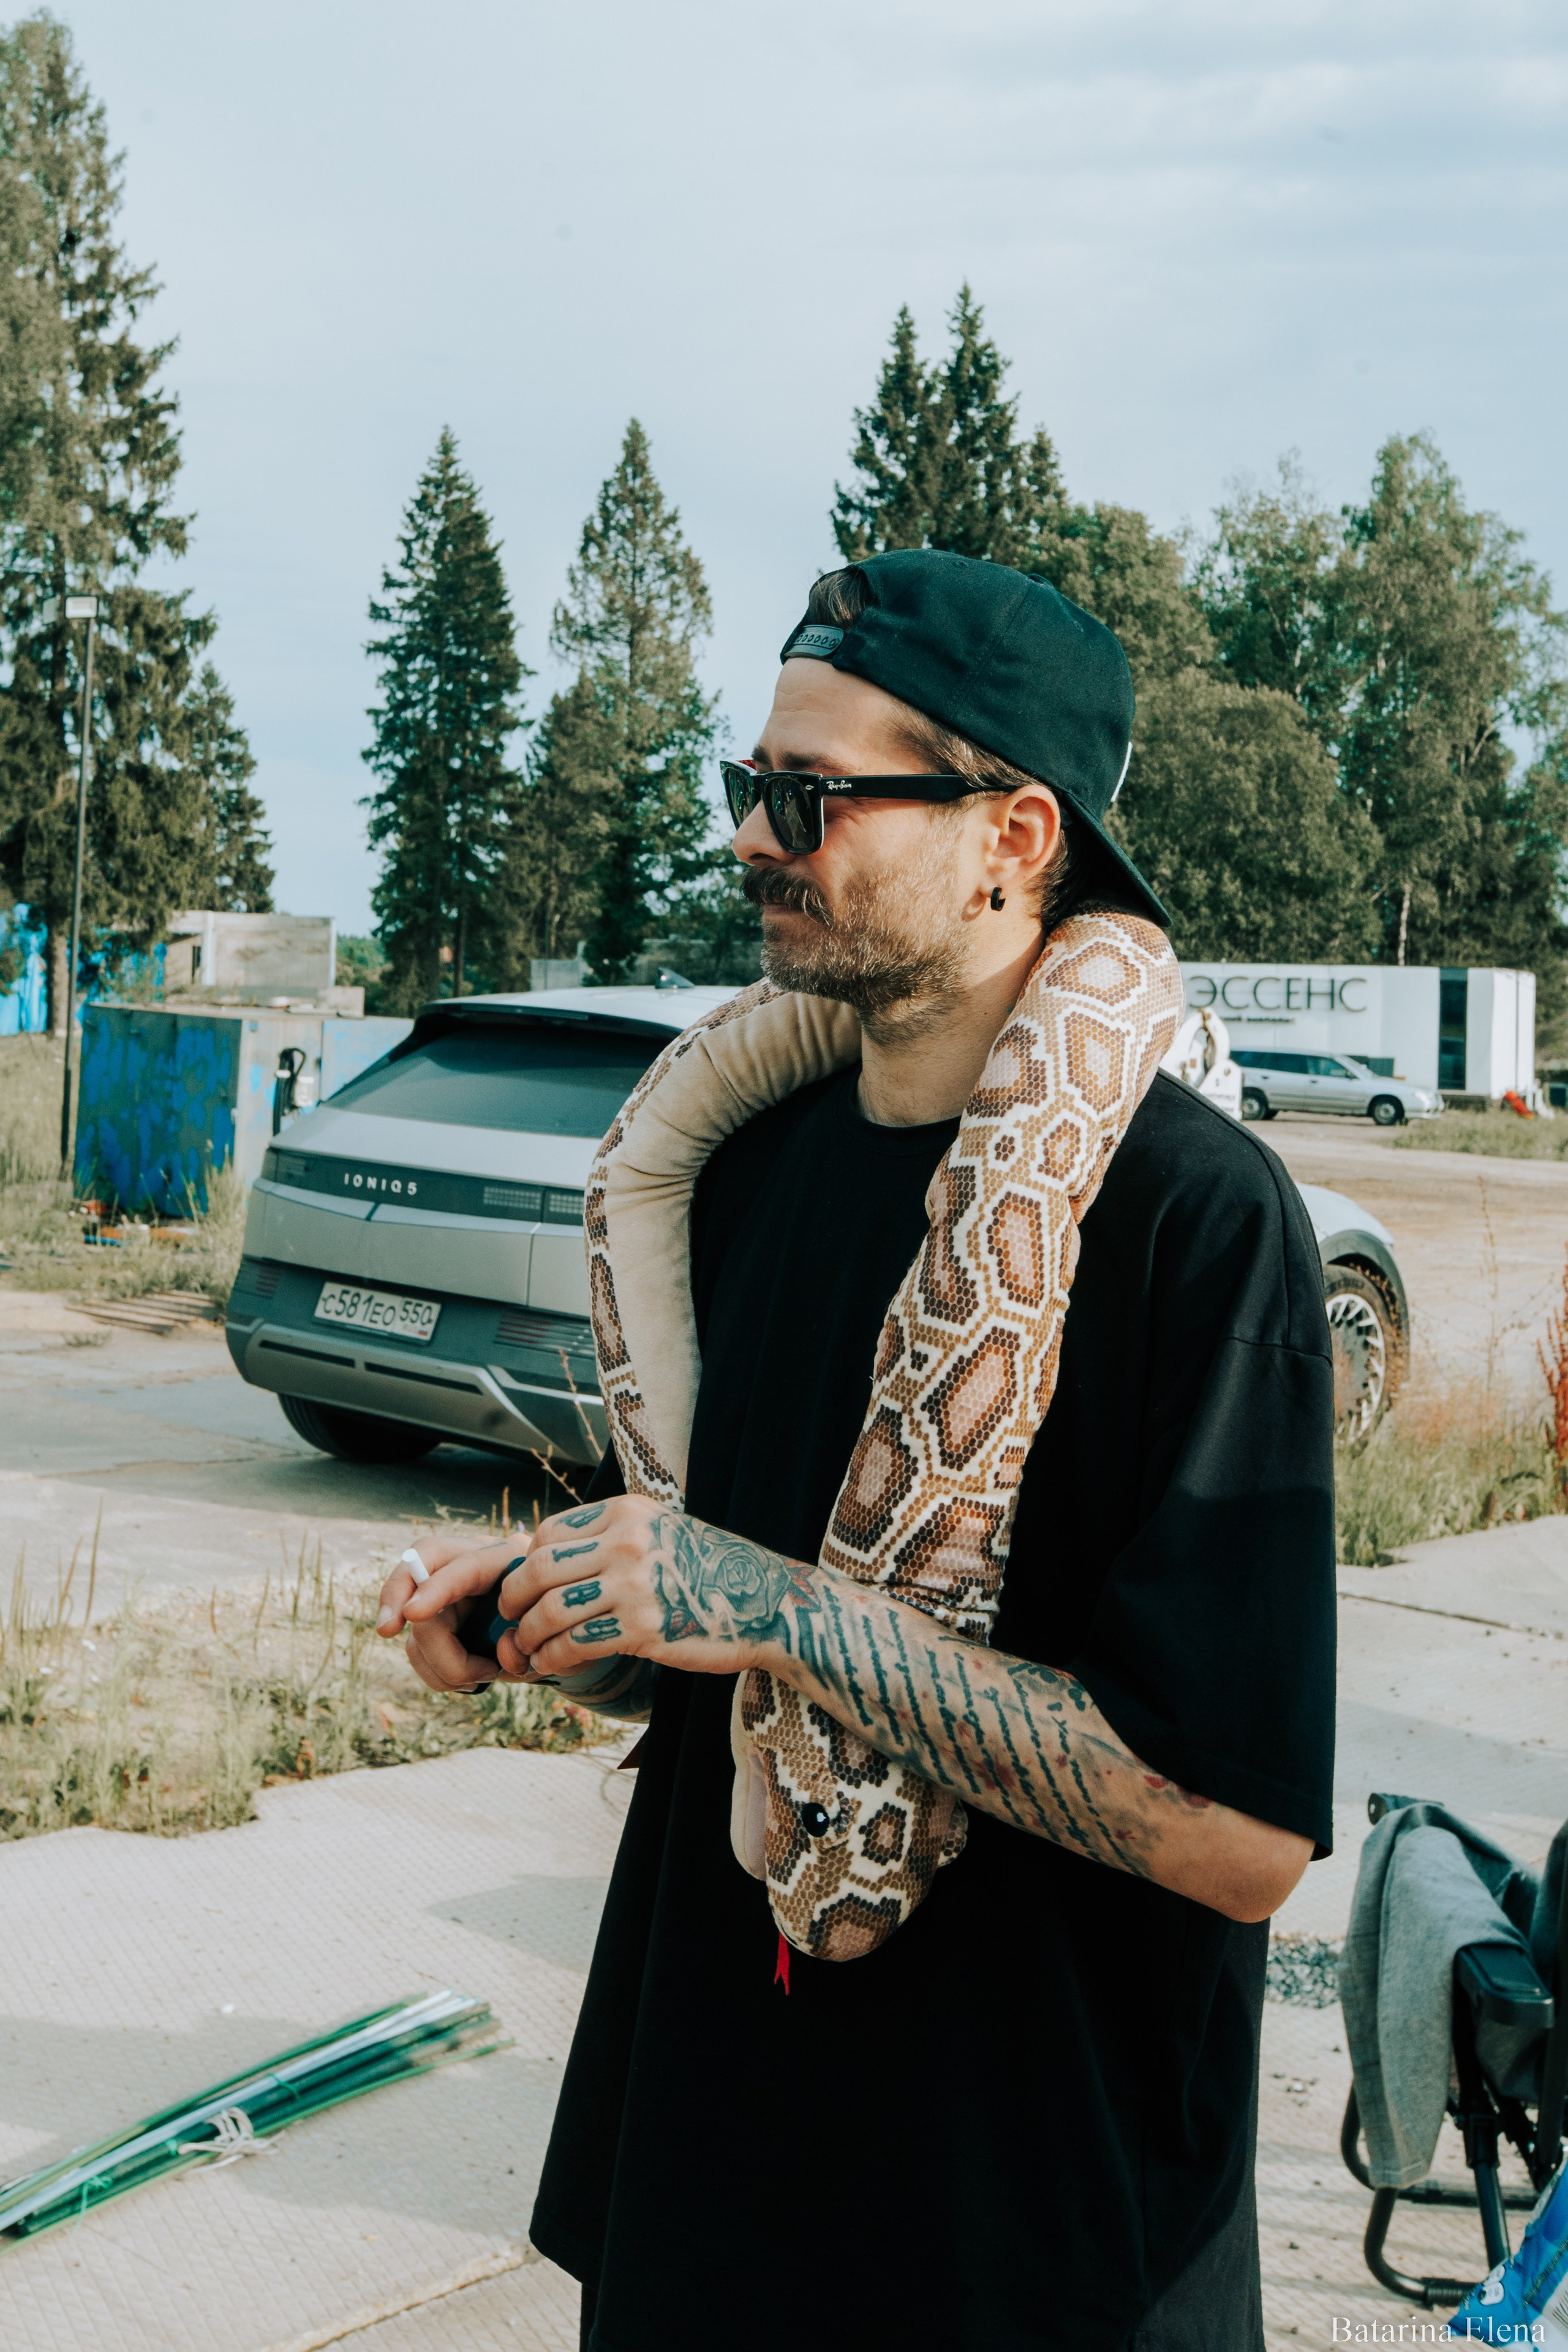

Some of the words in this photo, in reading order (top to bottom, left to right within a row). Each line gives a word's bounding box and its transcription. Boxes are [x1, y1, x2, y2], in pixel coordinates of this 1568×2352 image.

[826, 780, 852, 790] Ray-Ban
[1189, 976, 1366, 1012] ЭССЕНС
[344, 1173, 402, 1194] IONIQ
[407, 1182, 417, 1196] 5
